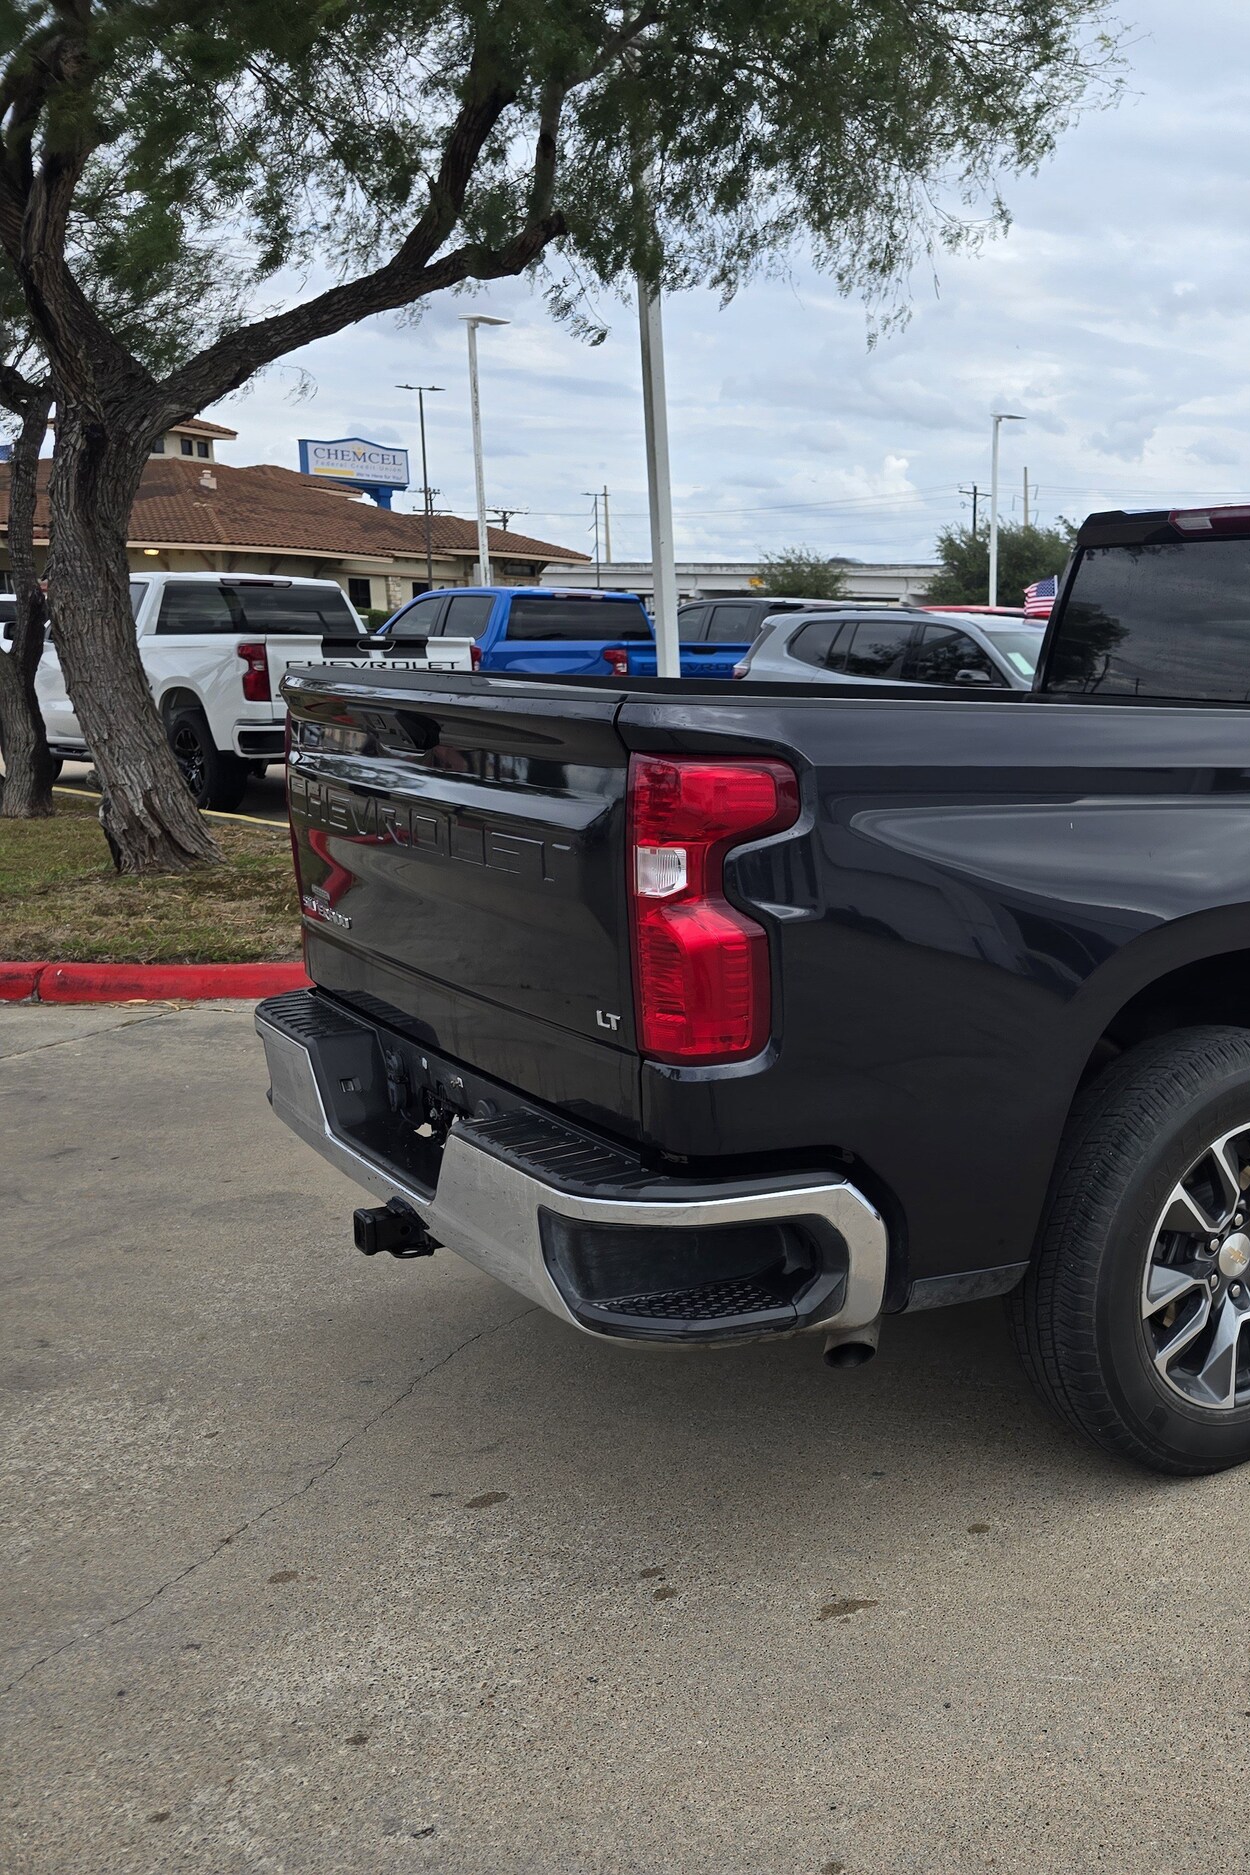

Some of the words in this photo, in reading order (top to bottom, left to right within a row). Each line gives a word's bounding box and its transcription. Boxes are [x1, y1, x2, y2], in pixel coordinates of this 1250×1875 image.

[313, 447, 403, 466] CHEMCEL
[315, 460, 347, 468] Federal
[288, 773, 578, 883] CHEVROLET
[596, 1010, 621, 1031] LT
